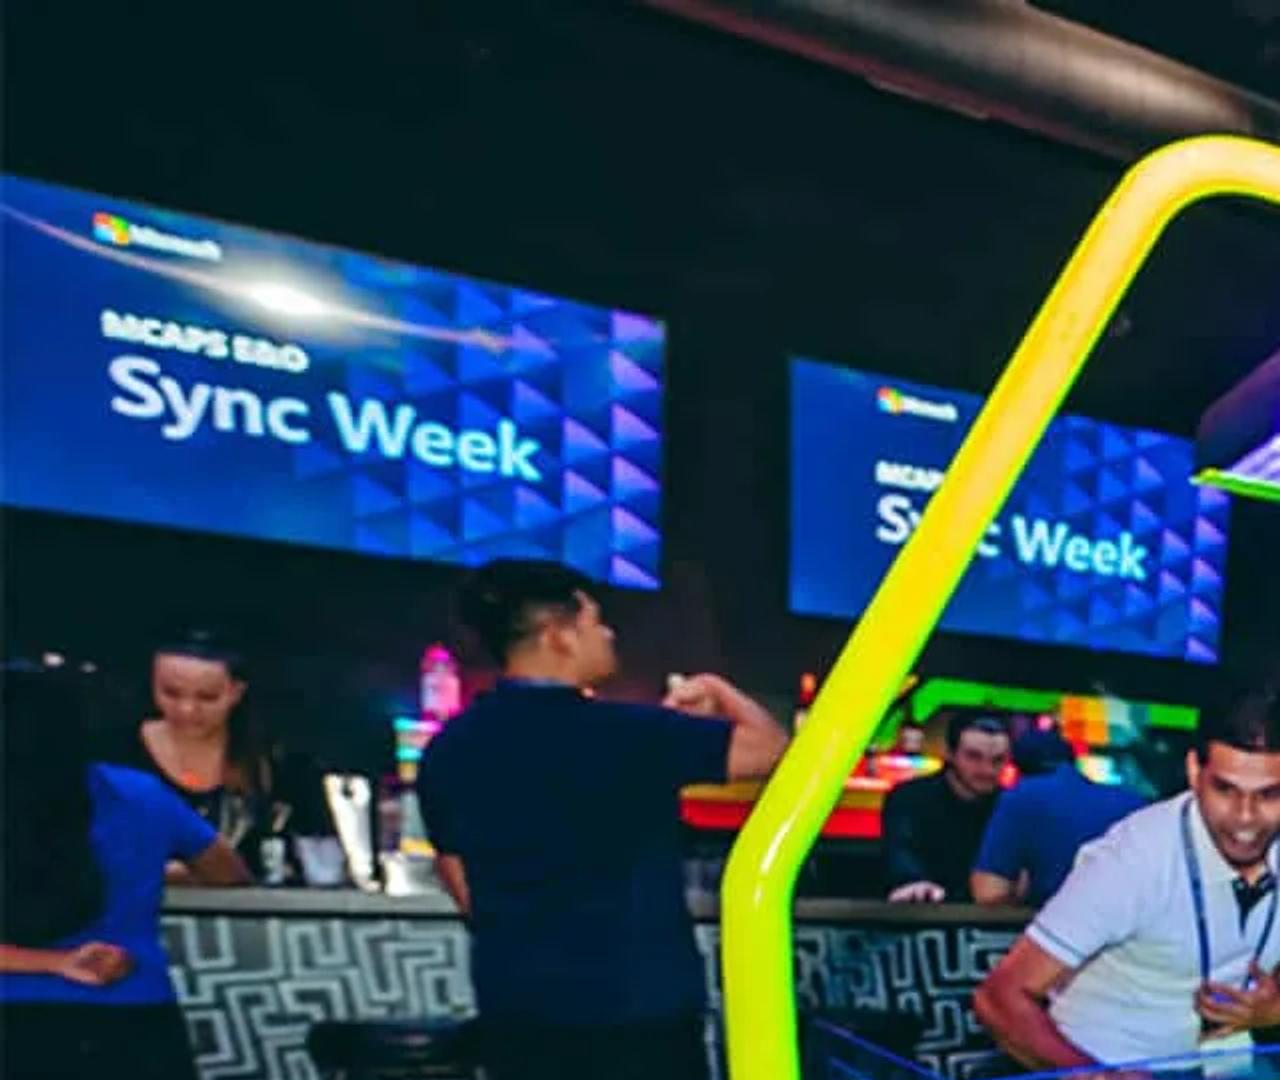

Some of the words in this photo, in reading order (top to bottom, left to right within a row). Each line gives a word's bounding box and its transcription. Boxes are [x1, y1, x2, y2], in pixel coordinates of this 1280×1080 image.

[108, 354, 312, 441] Sync
[326, 390, 543, 482] Week
[1011, 515, 1149, 580] Week
